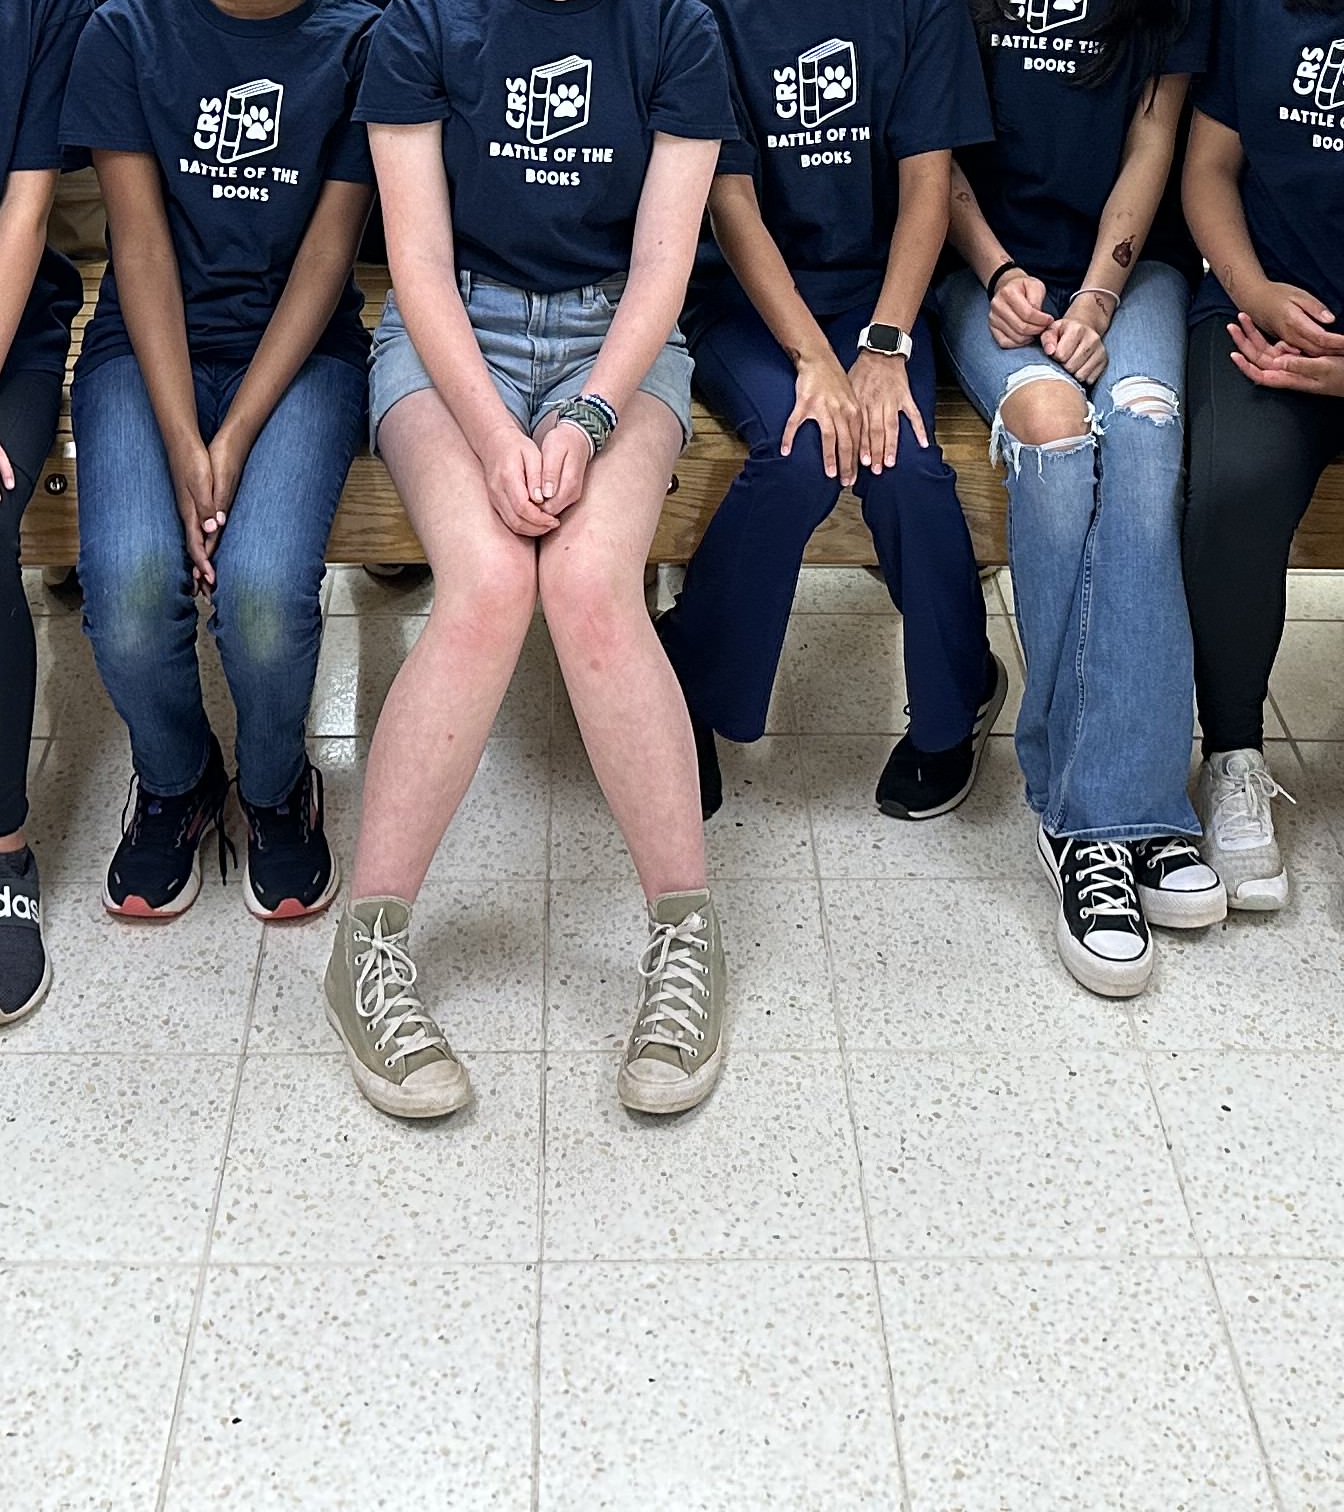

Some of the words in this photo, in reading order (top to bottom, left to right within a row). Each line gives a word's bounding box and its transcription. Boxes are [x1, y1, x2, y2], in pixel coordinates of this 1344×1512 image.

[991, 34, 1047, 50] BATTLE
[1052, 38, 1073, 51] OF
[1024, 57, 1076, 73] BOOKS
[1293, 46, 1324, 95] CRS
[773, 66, 797, 118] CRS
[506, 77, 527, 129] CRS
[193, 97, 222, 150] CRS
[1279, 106, 1335, 128] BATTLE
[767, 130, 822, 148] BATTLE
[826, 127, 846, 141] OF
[489, 142, 548, 162] BATTLE
[553, 147, 577, 162] OF
[582, 148, 614, 163] THE
[801, 151, 852, 168] BOOKS
[179, 158, 238, 178] BATTLE
[243, 167, 267, 179] OF
[272, 167, 299, 185] THE
[525, 168, 581, 186] BOOKS
[212, 184, 269, 202] BOOKS
